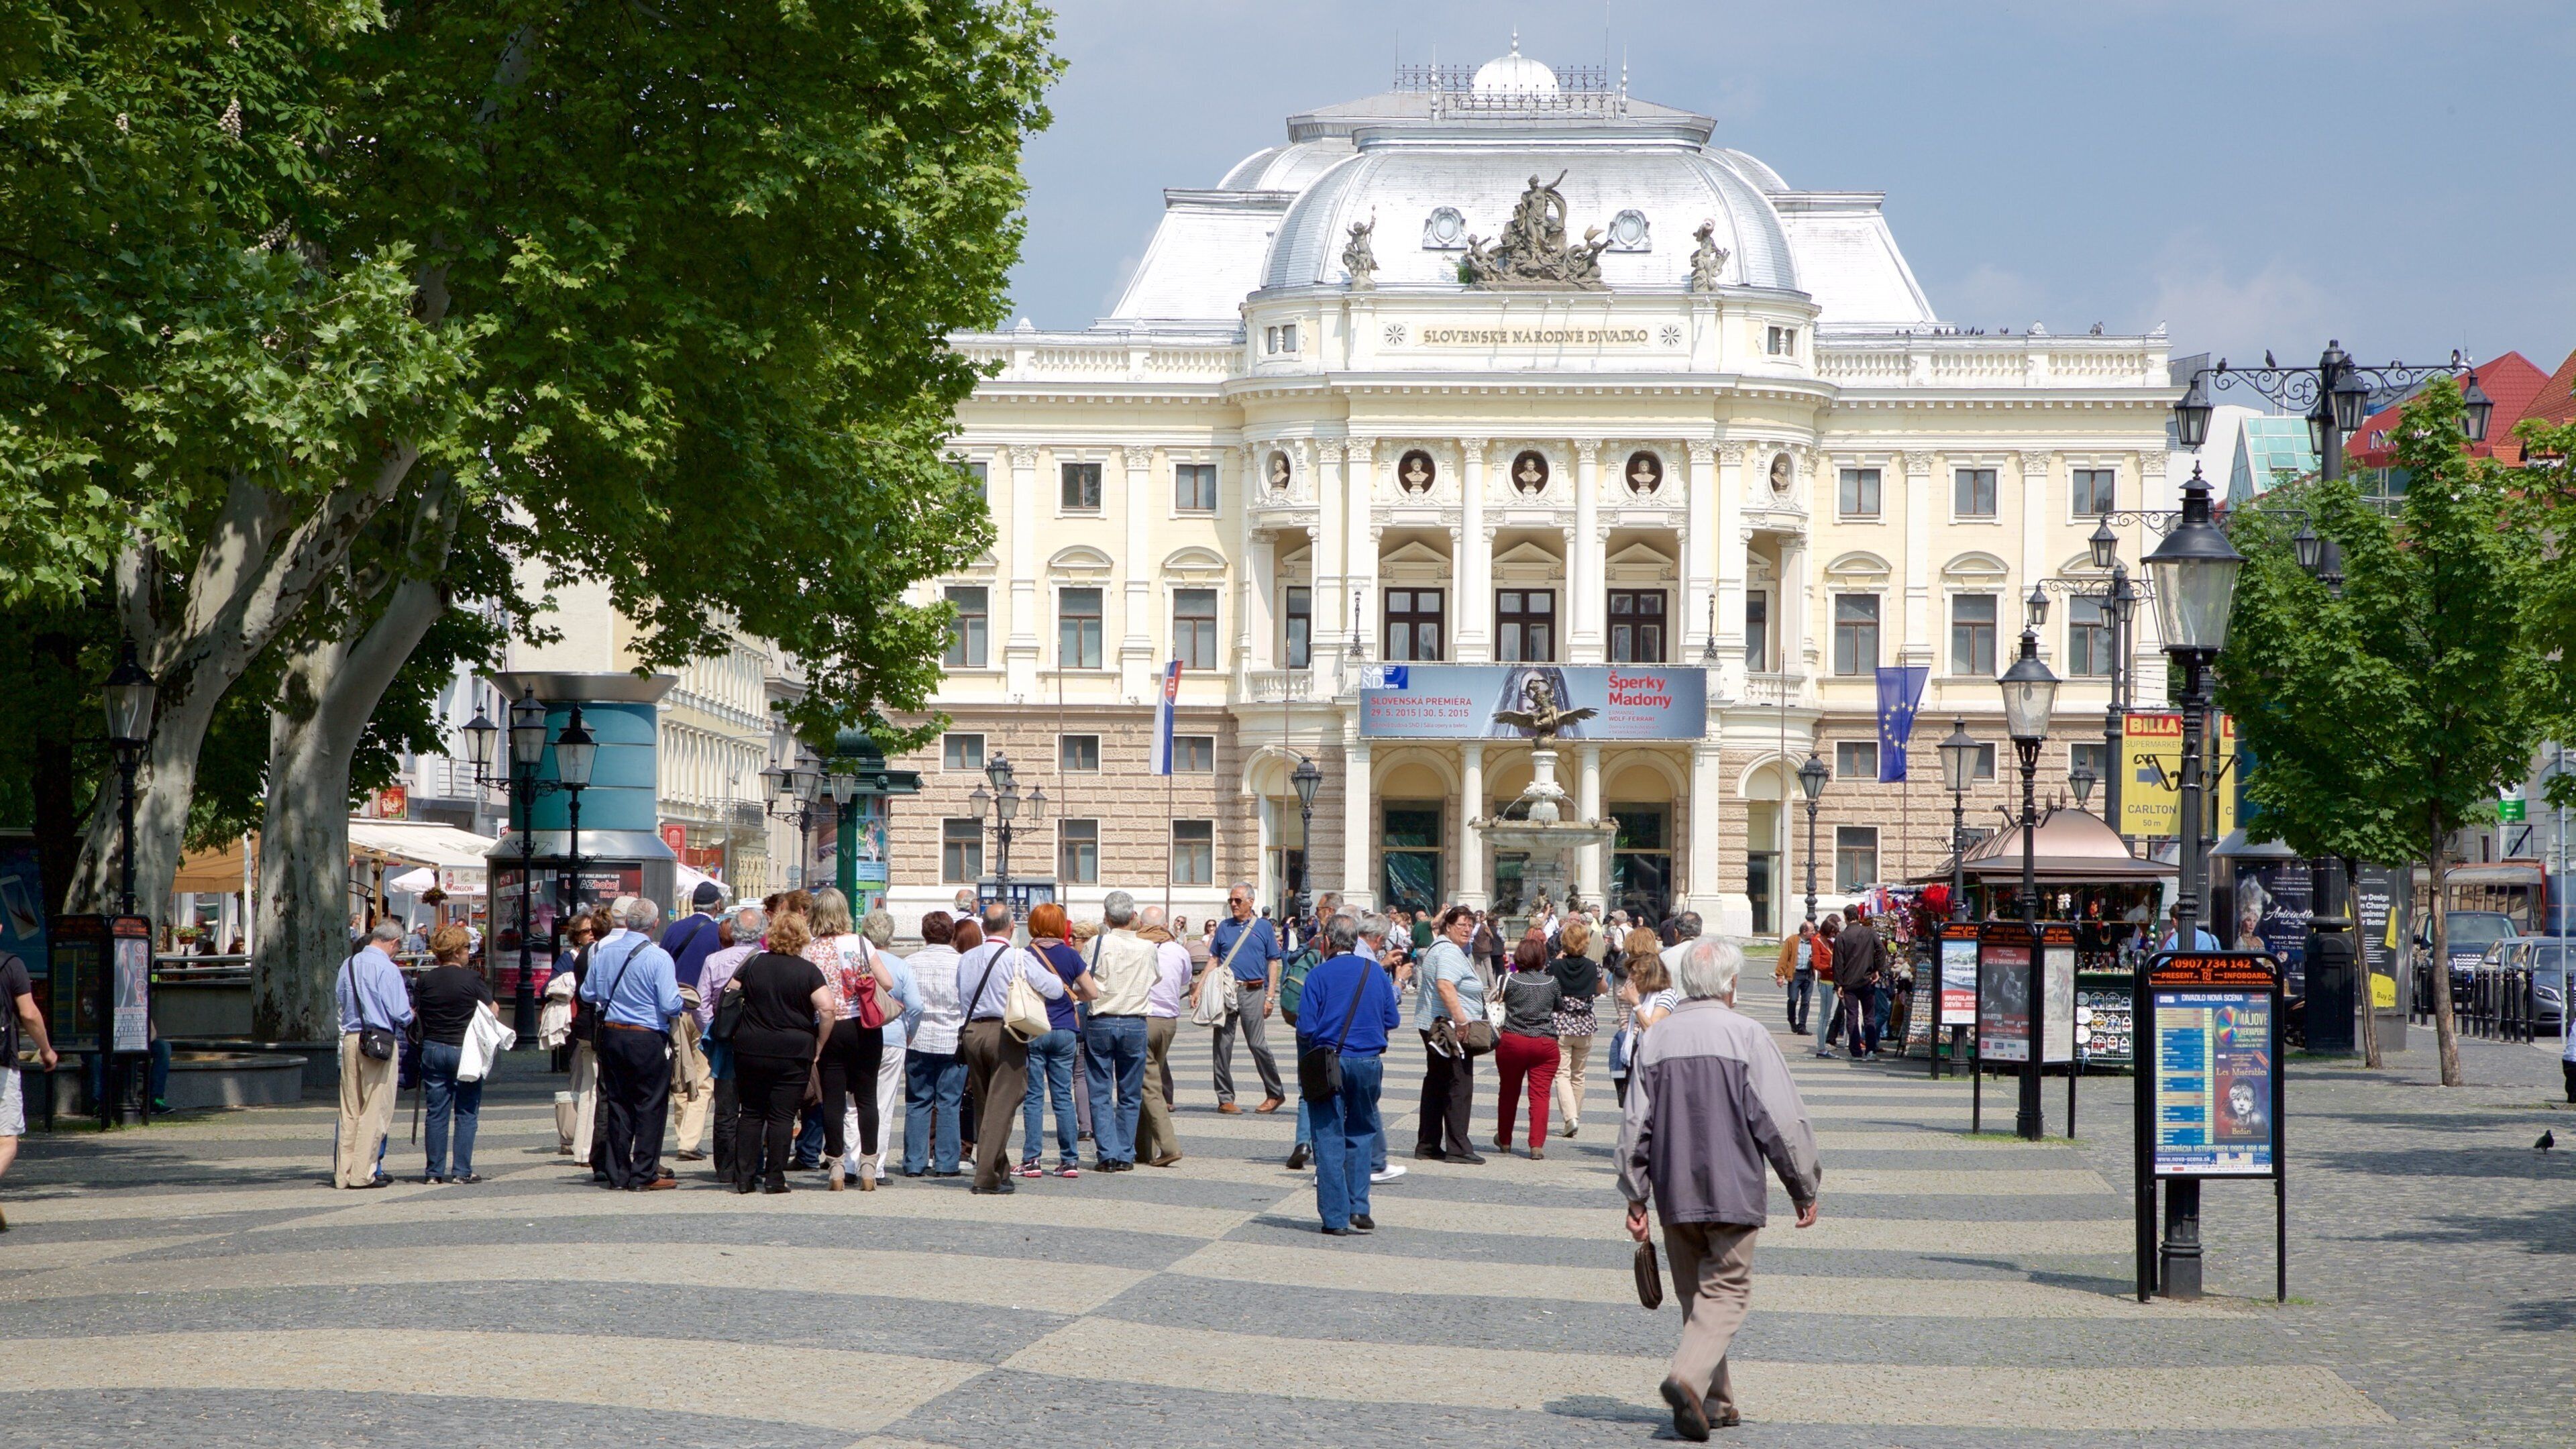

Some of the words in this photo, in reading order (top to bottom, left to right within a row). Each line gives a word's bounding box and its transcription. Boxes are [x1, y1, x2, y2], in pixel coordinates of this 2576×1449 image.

[1424, 327, 1507, 343] SLOVENSKÉ
[1513, 327, 1584, 343] NÁRODNÉ
[1588, 329, 1648, 343] DIVADLO
[1608, 670, 1666, 692] Šperky
[1371, 695, 1424, 706] SLOVENSKÁ
[1426, 695, 1472, 706] PREMIÉRA
[1609, 692, 1672, 709] Madony
[1395, 708, 1416, 716] 2015
[1424, 709, 1437, 717] 30.
[1448, 709, 1469, 717] 2015
[2129, 718, 2178, 733] BILLA
[2125, 740, 2182, 748] SUPERMARKET
[2128, 804, 2177, 814] CARLTON
[580, 879, 620, 891] AZhokej
[2369, 894, 2390, 902] Design
[2365, 902, 2390, 910] Change
[2175, 959, 2203, 968] 0907
[2206, 959, 2227, 968] 734
[2231, 959, 2251, 968] 142
[2207, 993, 2223, 1002] NOVÁ
[2224, 993, 2243, 1002] SCÉNA
[2377, 991, 2387, 1000] Buy
[2239, 1009, 2268, 1025] MÁJOVÉ
[2216, 1067, 2229, 1075] Les
[2232, 1067, 2267, 1075] Misérables
[2157, 1144, 2192, 1152] REZERVÁCIA
